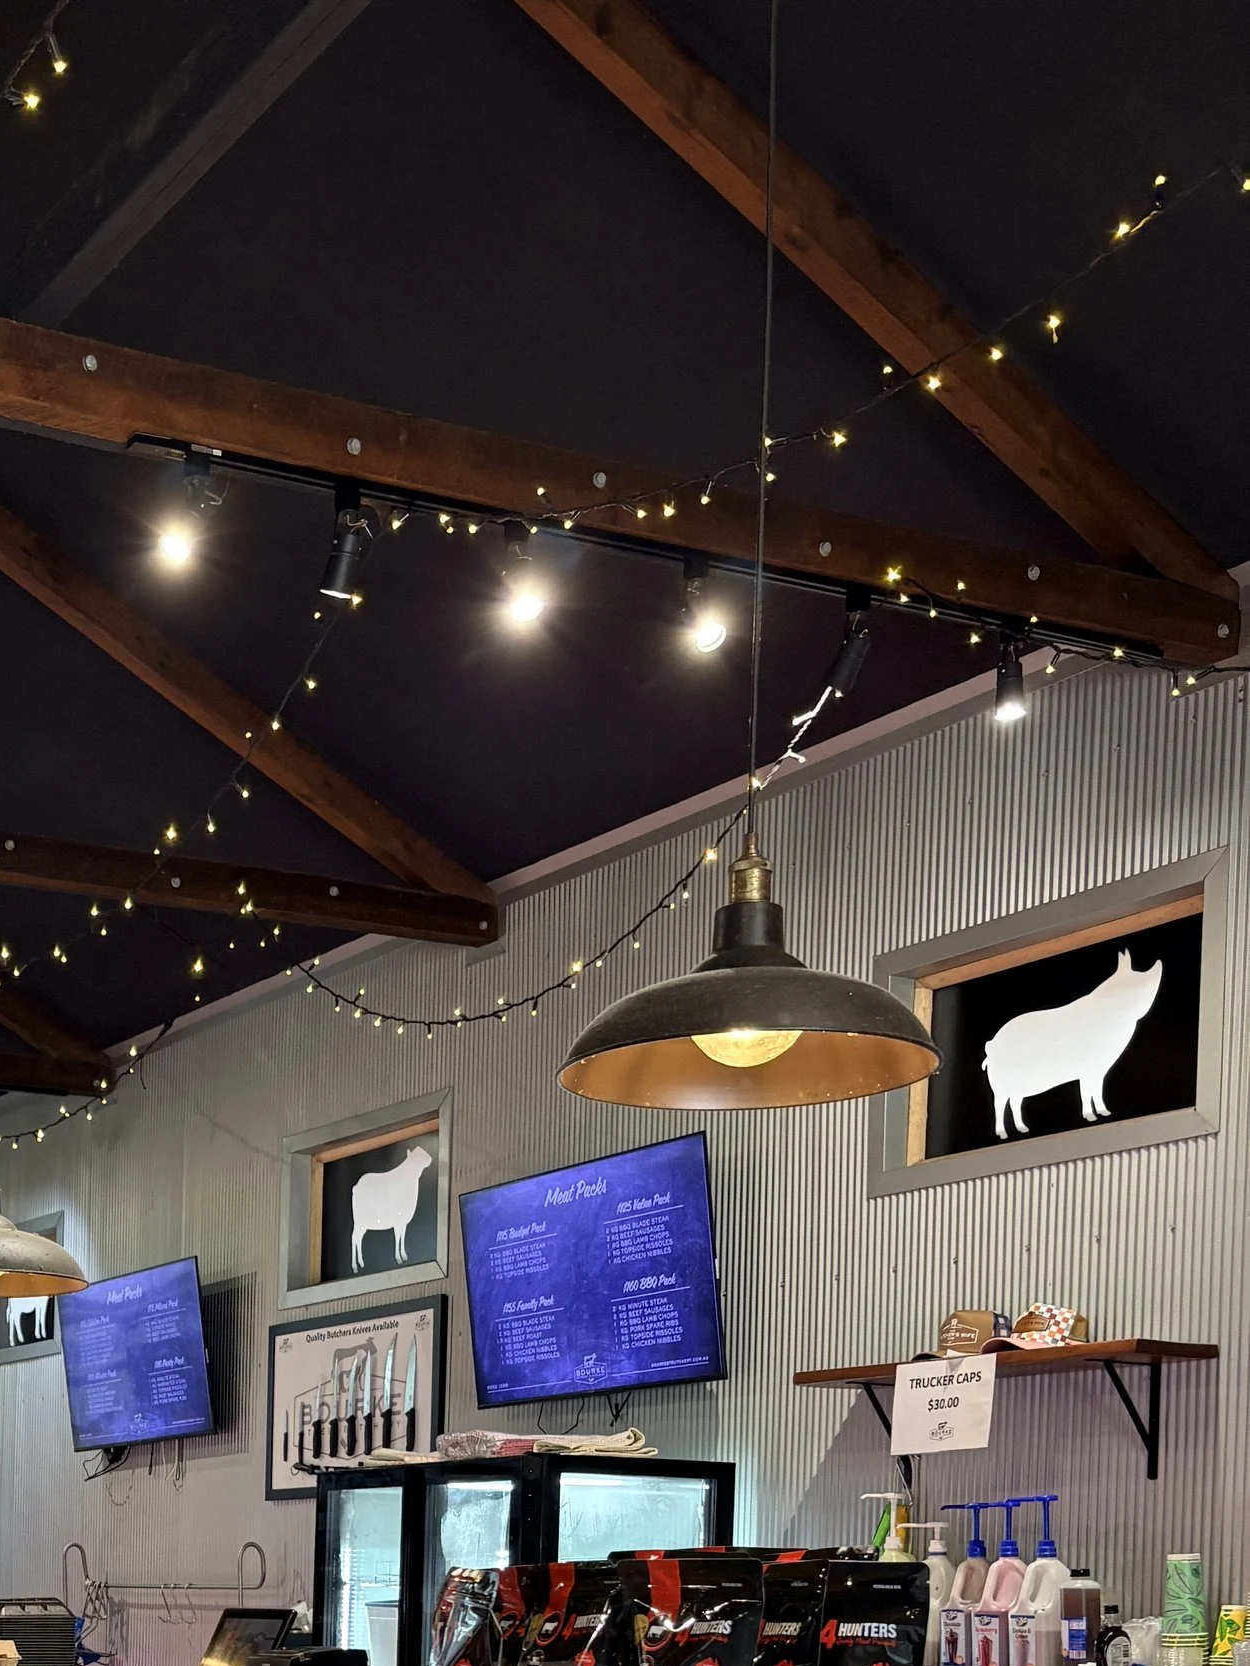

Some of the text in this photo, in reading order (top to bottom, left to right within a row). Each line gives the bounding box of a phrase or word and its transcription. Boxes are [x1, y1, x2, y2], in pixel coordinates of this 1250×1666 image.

[544, 1177, 607, 1208] Meat Packs
[633, 1198, 652, 1211] Value
[653, 1192, 670, 1206] Pack
[651, 1216, 669, 1225] STEAK
[530, 1221, 546, 1234] Pack
[635, 1224, 665, 1236] SAUSAGES
[650, 1231, 670, 1241] CHOPS
[658, 1272, 676, 1287] Pack
[539, 1294, 554, 1307] Pack
[650, 1297, 668, 1306] STEAK
[644, 1304, 674, 1315] SAUSAGES
[658, 1311, 679, 1320] CHOPS
[306, 1320, 399, 1343] Quality Butchers Knives Available
[576, 1366, 605, 1377] BOURKE
[909, 1371, 982, 1390] TRUCKER CAPS
[927, 1396, 960, 1413] $30.00
[691, 1619, 733, 1635] HUNTERS
[763, 1622, 801, 1636] HUNTERS
[820, 1619, 838, 1649] 4
[838, 1622, 897, 1638] HUNTERS
